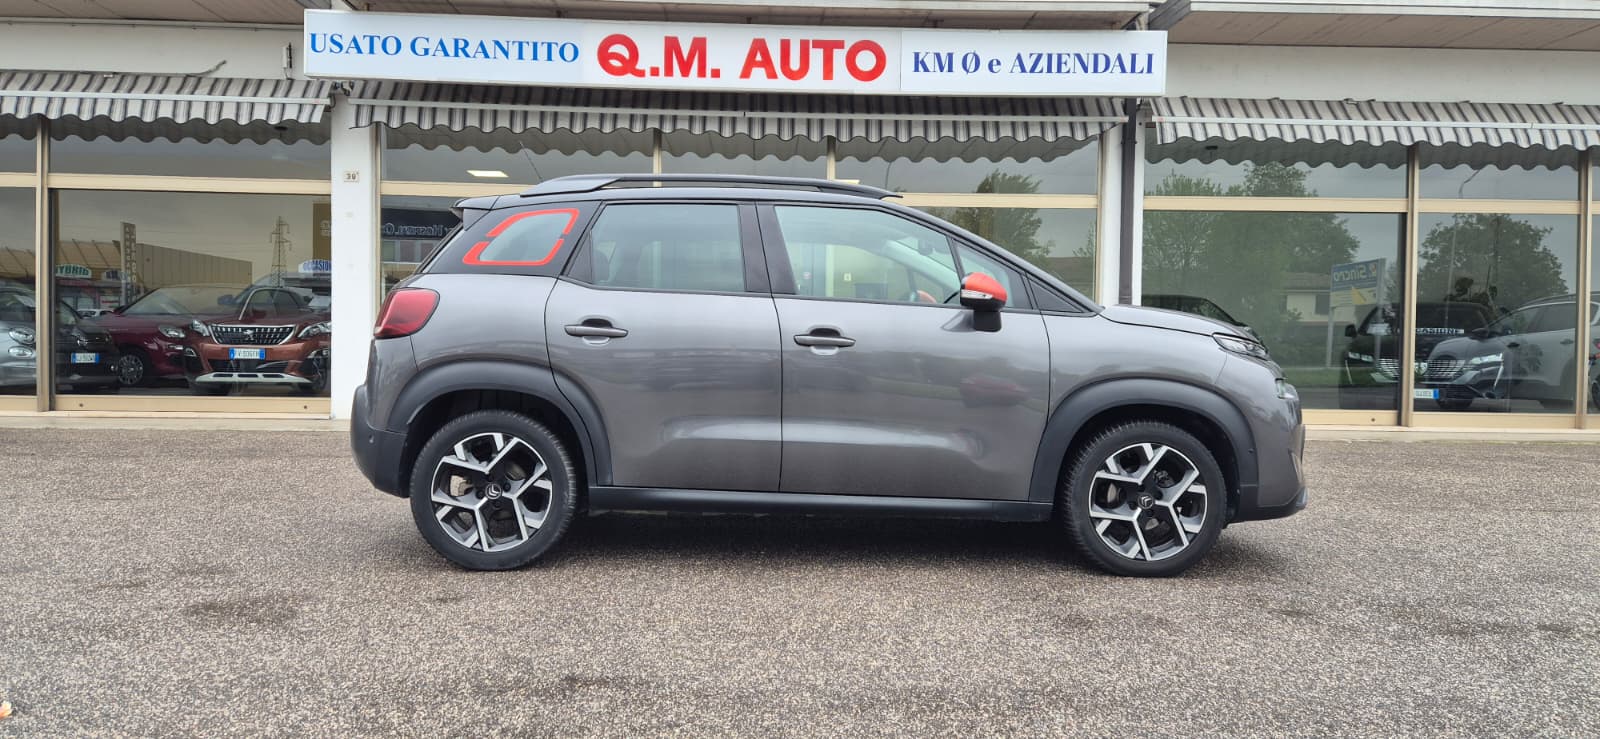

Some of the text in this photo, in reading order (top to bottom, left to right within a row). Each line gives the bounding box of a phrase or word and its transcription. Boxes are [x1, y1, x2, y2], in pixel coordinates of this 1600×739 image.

[308, 33, 580, 63] USATO GARANTITO
[597, 34, 887, 83] Q.M. AUTO
[912, 53, 954, 73] KM
[987, 57, 1002, 74] e
[1010, 52, 1154, 75] AZIENDALI
